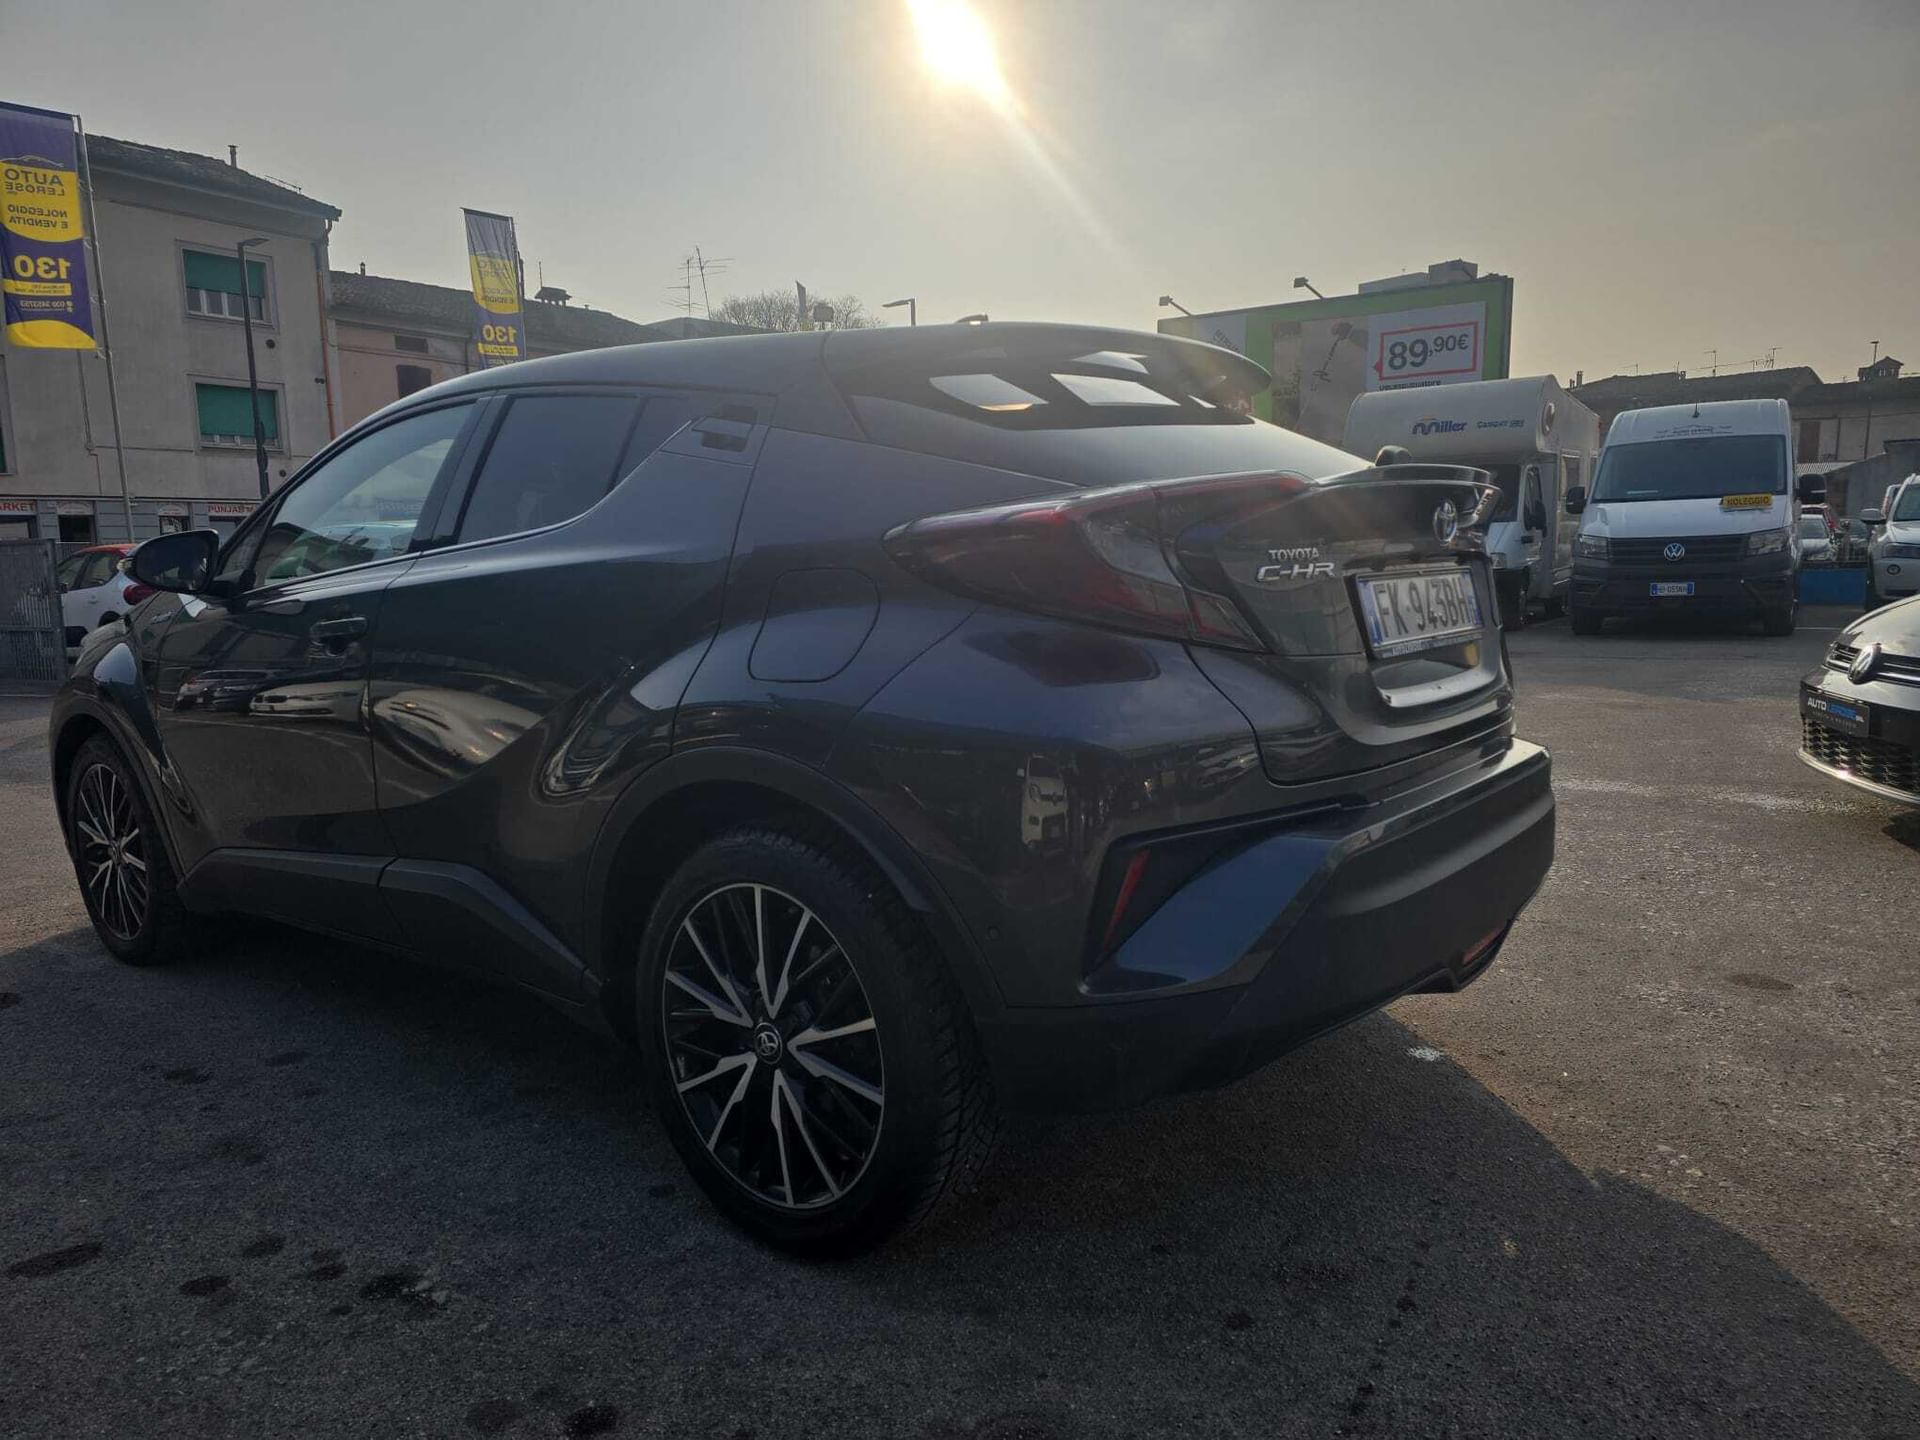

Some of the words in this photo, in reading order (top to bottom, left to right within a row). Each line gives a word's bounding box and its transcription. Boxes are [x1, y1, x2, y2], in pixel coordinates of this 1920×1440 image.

[1388, 333, 1470, 370] 89,90€
[1412, 419, 1468, 436] Miller
[1268, 547, 1320, 560] TOYOTA
[1256, 562, 1336, 583] C-HR
[1807, 697, 1827, 712] AUTO
